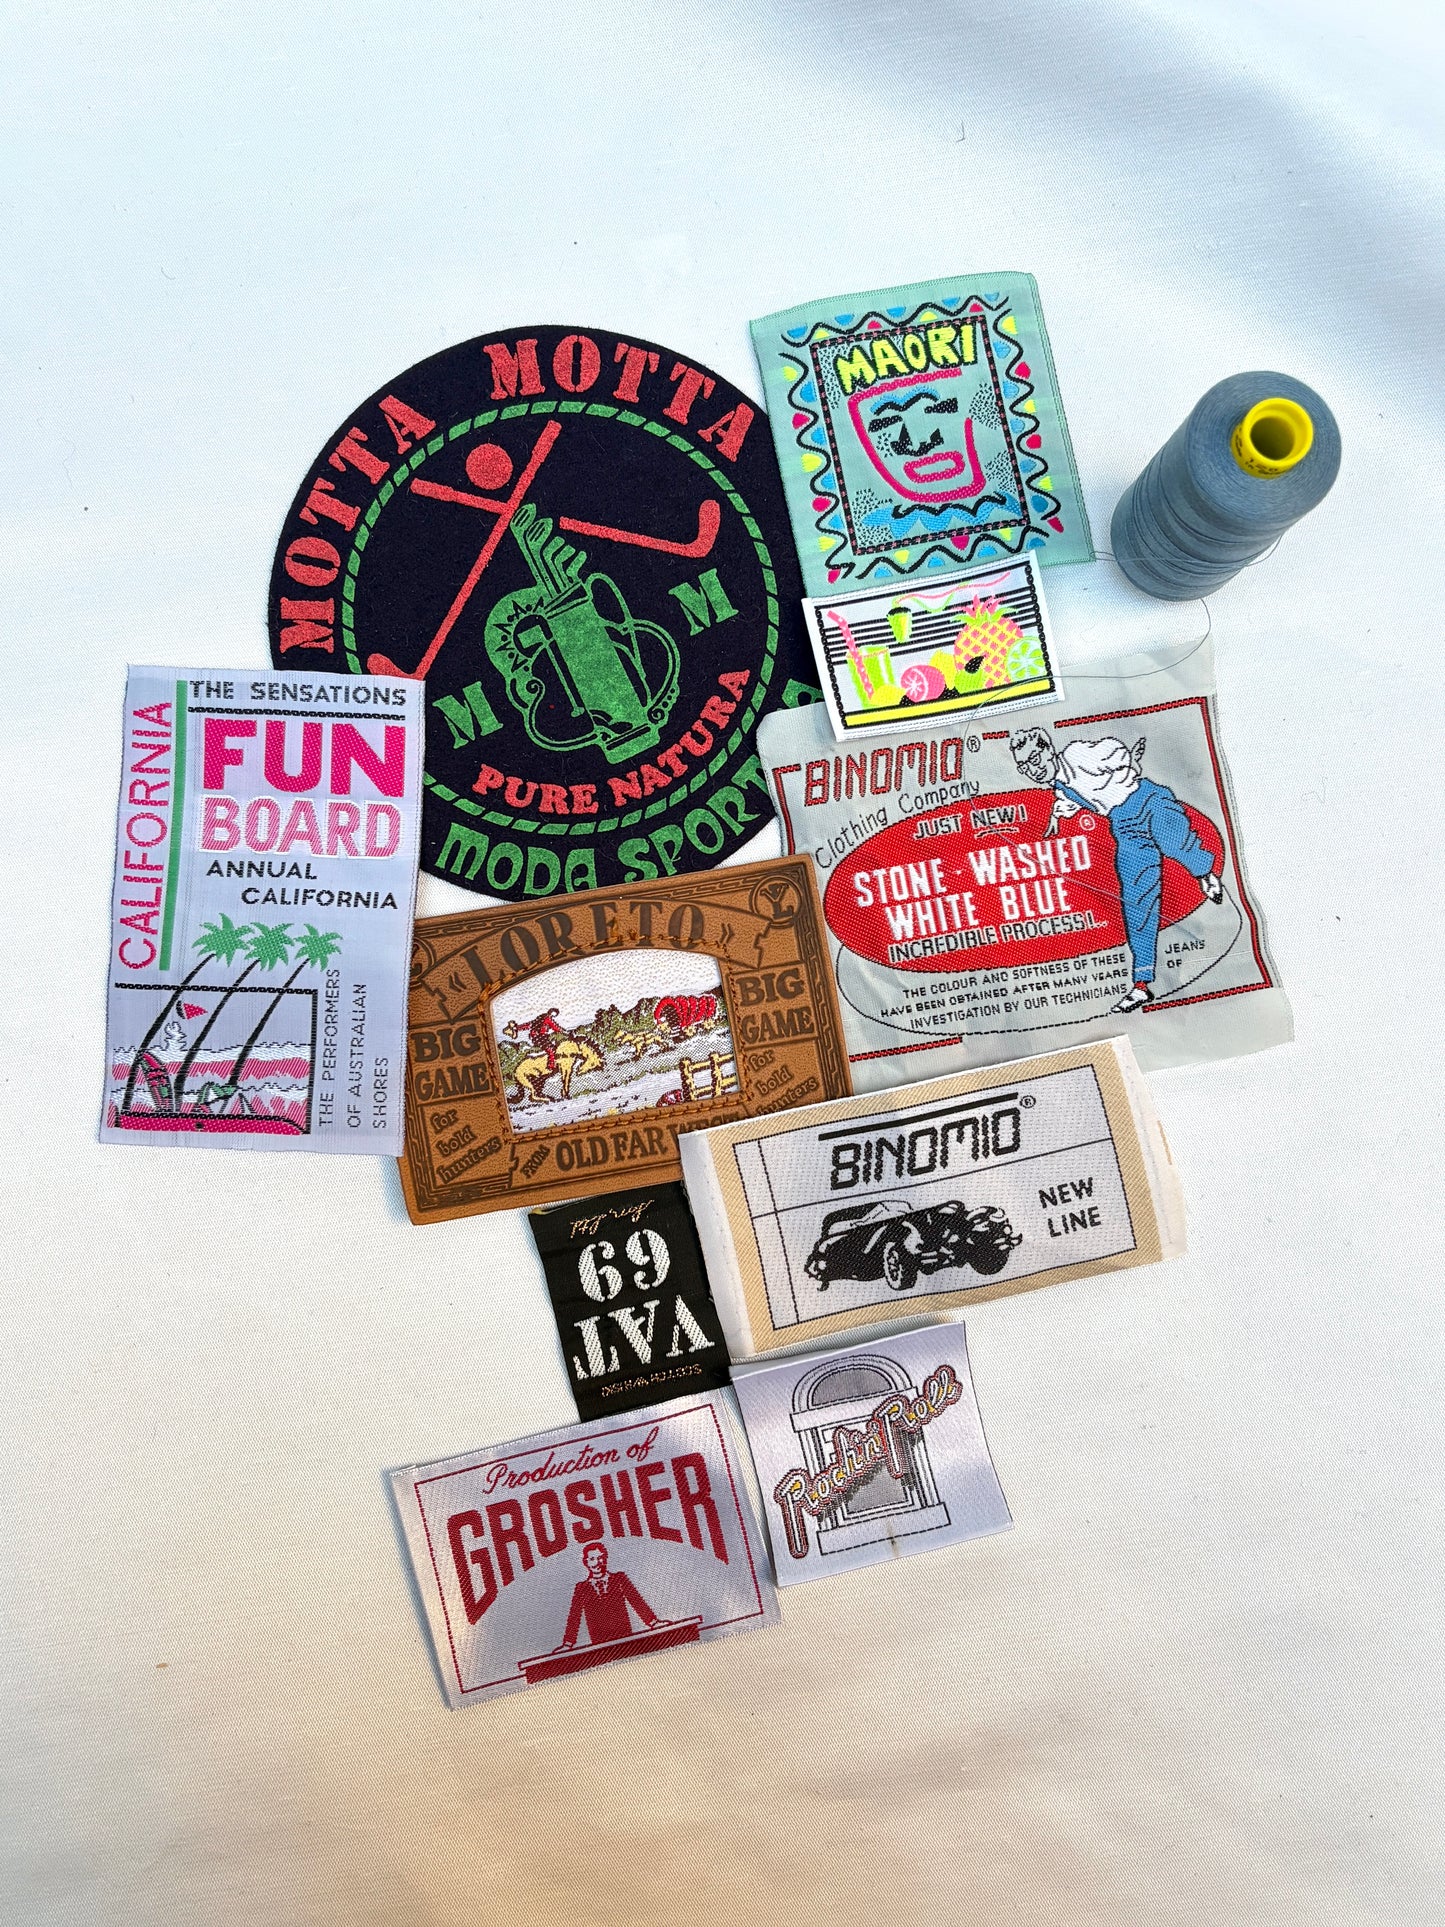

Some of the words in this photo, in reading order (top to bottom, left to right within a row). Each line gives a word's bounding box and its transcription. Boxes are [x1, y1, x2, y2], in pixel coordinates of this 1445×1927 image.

[834, 321, 980, 395] MAORI
[279, 395, 436, 654] MOTTA
[483, 335, 755, 463] MOTTA
[669, 568, 739, 636] M
[189, 680, 235, 700] THE
[250, 682, 407, 707] SENSATIONS
[431, 681, 504, 749] M
[204, 717, 406, 798] FUN
[473, 764, 599, 814] PURE
[613, 669, 752, 807] NATURA
[118, 701, 173, 970] CALIFORNIA
[199, 793, 402, 859] BOARD
[815, 806, 888, 869] Clothing
[898, 779, 980, 814] Company
[914, 815, 962, 840] JUST
[206, 859, 317, 879] ANNUAL
[435, 823, 598, 895] MODA
[853, 858, 947, 908] STONE
[968, 835, 1092, 886] WASHED
[241, 888, 398, 910] CALIFORNIA
[885, 892, 980, 941] WHITE
[998, 878, 1072, 921] BLUE
[888, 926, 998, 963] INCREDIBLE
[1165, 939, 1206, 955] JEANS
[1166, 959, 1182, 969] OF
[736, 968, 805, 1008] BIG
[880, 1005, 913, 1018] HAVE
[915, 998, 946, 1012] BEEN
[949, 987, 1008, 1006] OBTAINED
[1012, 981, 1051, 995] AFTER
[902, 987, 927, 999] THE
[930, 976, 978, 995] COLOUR
[982, 971, 1009, 986] AND
[1012, 962, 1070, 980] SOFTNESS
[1073, 960, 1088, 971] OF
[1091, 953, 1126, 967] THESE
[322, 969, 340, 1088] PERFORMERS
[741, 1005, 815, 1044] GAME
[910, 1003, 1001, 1030] INVESTIGATION
[1003, 1000, 1020, 1013] BY
[1024, 996, 1049, 1010] OUR
[1051, 983, 1128, 1007] TECHNICIANS
[349, 983, 367, 1101] AUSTRALIAN
[410, 1023, 481, 1063] BIG
[750, 1050, 774, 1072] for
[373, 1056, 389, 1128] SHORES
[414, 1062, 489, 1100] GAME
[756, 1064, 793, 1097] bold
[318, 1092, 334, 1128] THE
[347, 1104, 361, 1128] OF
[430, 1107, 459, 1134] for
[435, 1125, 477, 1158] bold
[436, 1135, 502, 1185] hunters
[520, 1144, 550, 1179] FROM
[555, 1132, 611, 1172] OLD
[610, 1127, 668, 1162] FAR
[1038, 1177, 1094, 1209] NEW
[1048, 1209, 1102, 1238] LINE
[578, 1229, 671, 1303] 69
[573, 1294, 715, 1381] VAT
[483, 1446, 622, 1494] Production
[624, 1426, 660, 1462] of
[447, 1452, 729, 1626] GROSHER
